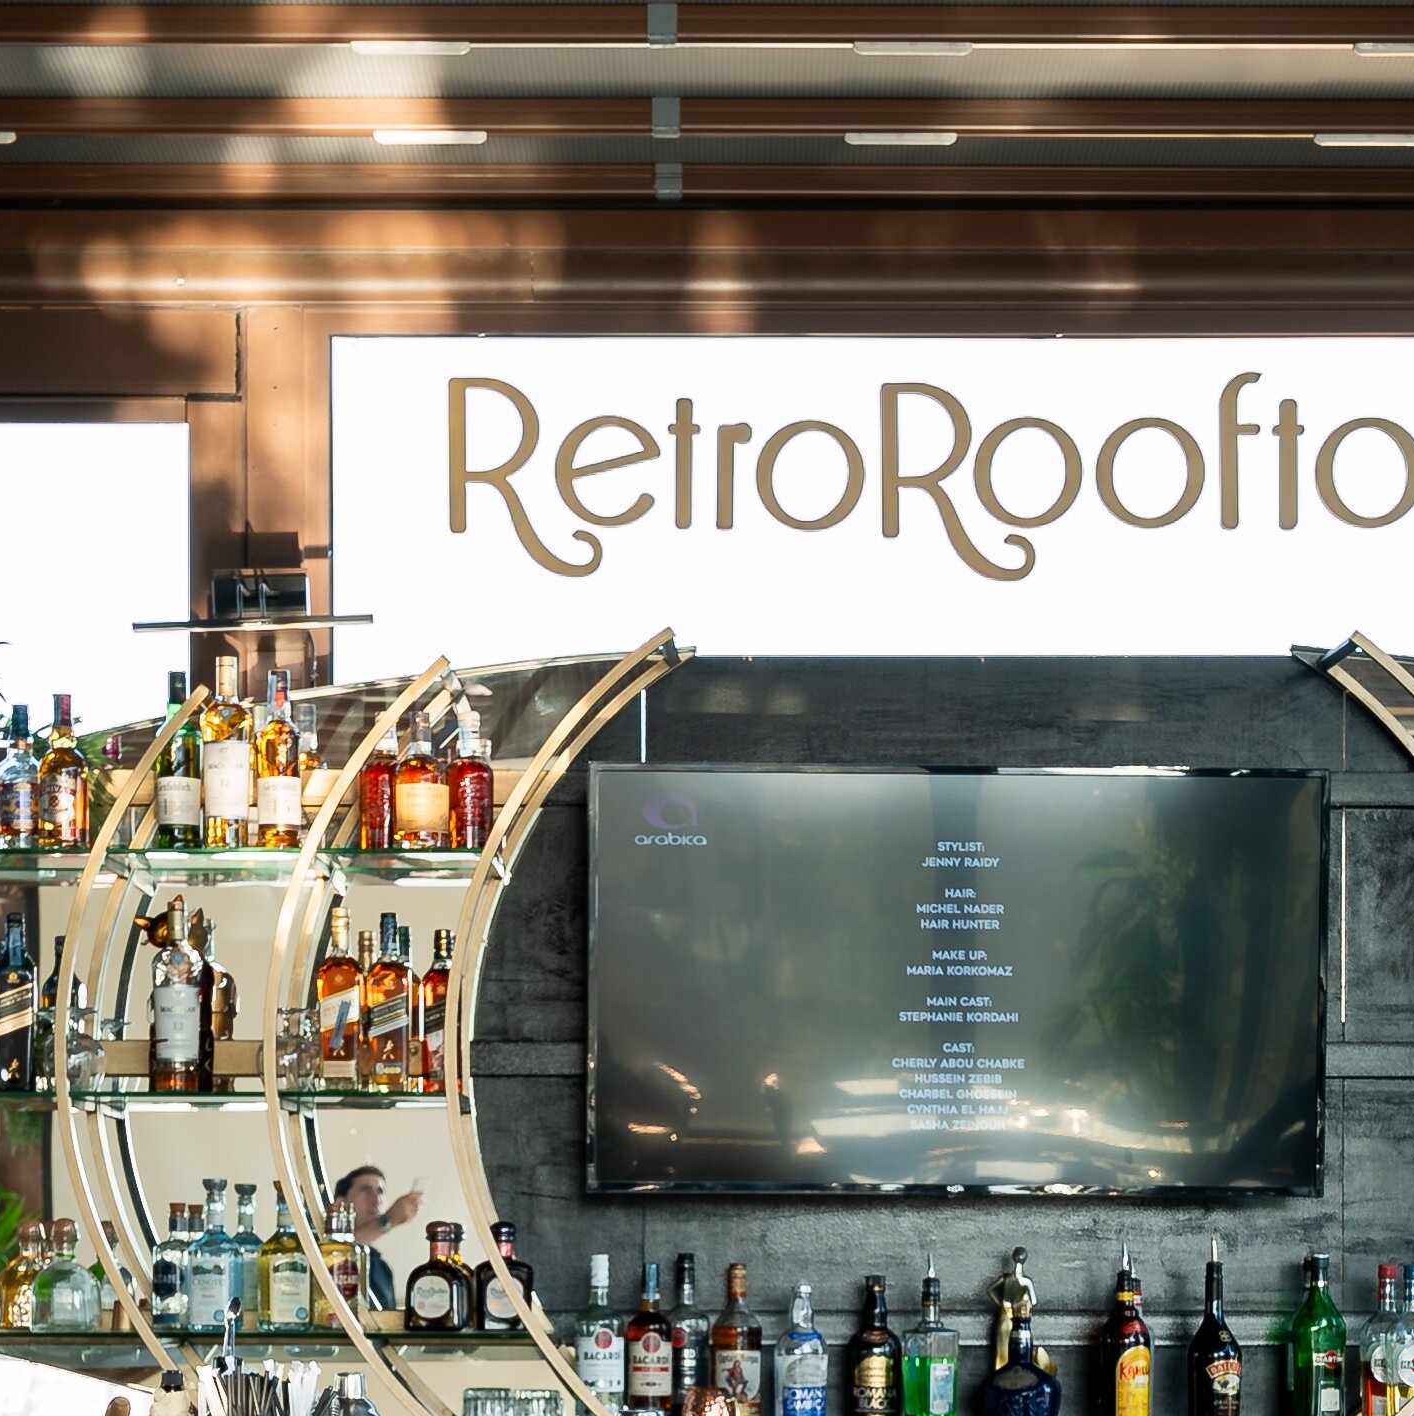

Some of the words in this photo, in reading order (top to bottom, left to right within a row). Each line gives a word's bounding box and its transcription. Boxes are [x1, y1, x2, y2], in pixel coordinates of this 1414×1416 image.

[937, 841, 985, 852] STYLIST:
[922, 857, 962, 867] JENNY
[964, 857, 1000, 868] RAIDY
[944, 888, 977, 899] HAIR:
[916, 903, 961, 914] MICHEL
[963, 904, 1005, 914] NADER
[920, 919, 950, 929] HAIR
[952, 919, 1000, 930] HUNTER
[932, 950, 966, 960] MAKE
[969, 950, 988, 960] UP:
[906, 965, 944, 975] MARIA
[947, 965, 1013, 976] KORKOMAZ
[926, 996, 957, 1007] MAIN
[959, 996, 993, 1007] CAST:
[899, 1011, 964, 1022] STEPHANIE
[966, 1012, 1019, 1022] KORDAHI
[942, 1042, 975, 1053] CAST:
[891, 1058, 938, 1068] CHERLY
[940, 1058, 974, 1068] ABOU
[976, 1058, 1025, 1069] CHABKE
[914, 1073, 966, 1084] HUSSEIN
[968, 1074, 1003, 1084] ZEBIB
[898, 1089, 954, 1099] CHARBEL
[956, 1089, 1018, 1099] GHOSSEIN
[907, 1104, 958, 1115] CYNTHIA
[961, 1104, 976, 1115] EL
[978, 1105, 1009, 1115] HAJJ
[910, 1119, 949, 1130] SASHA
